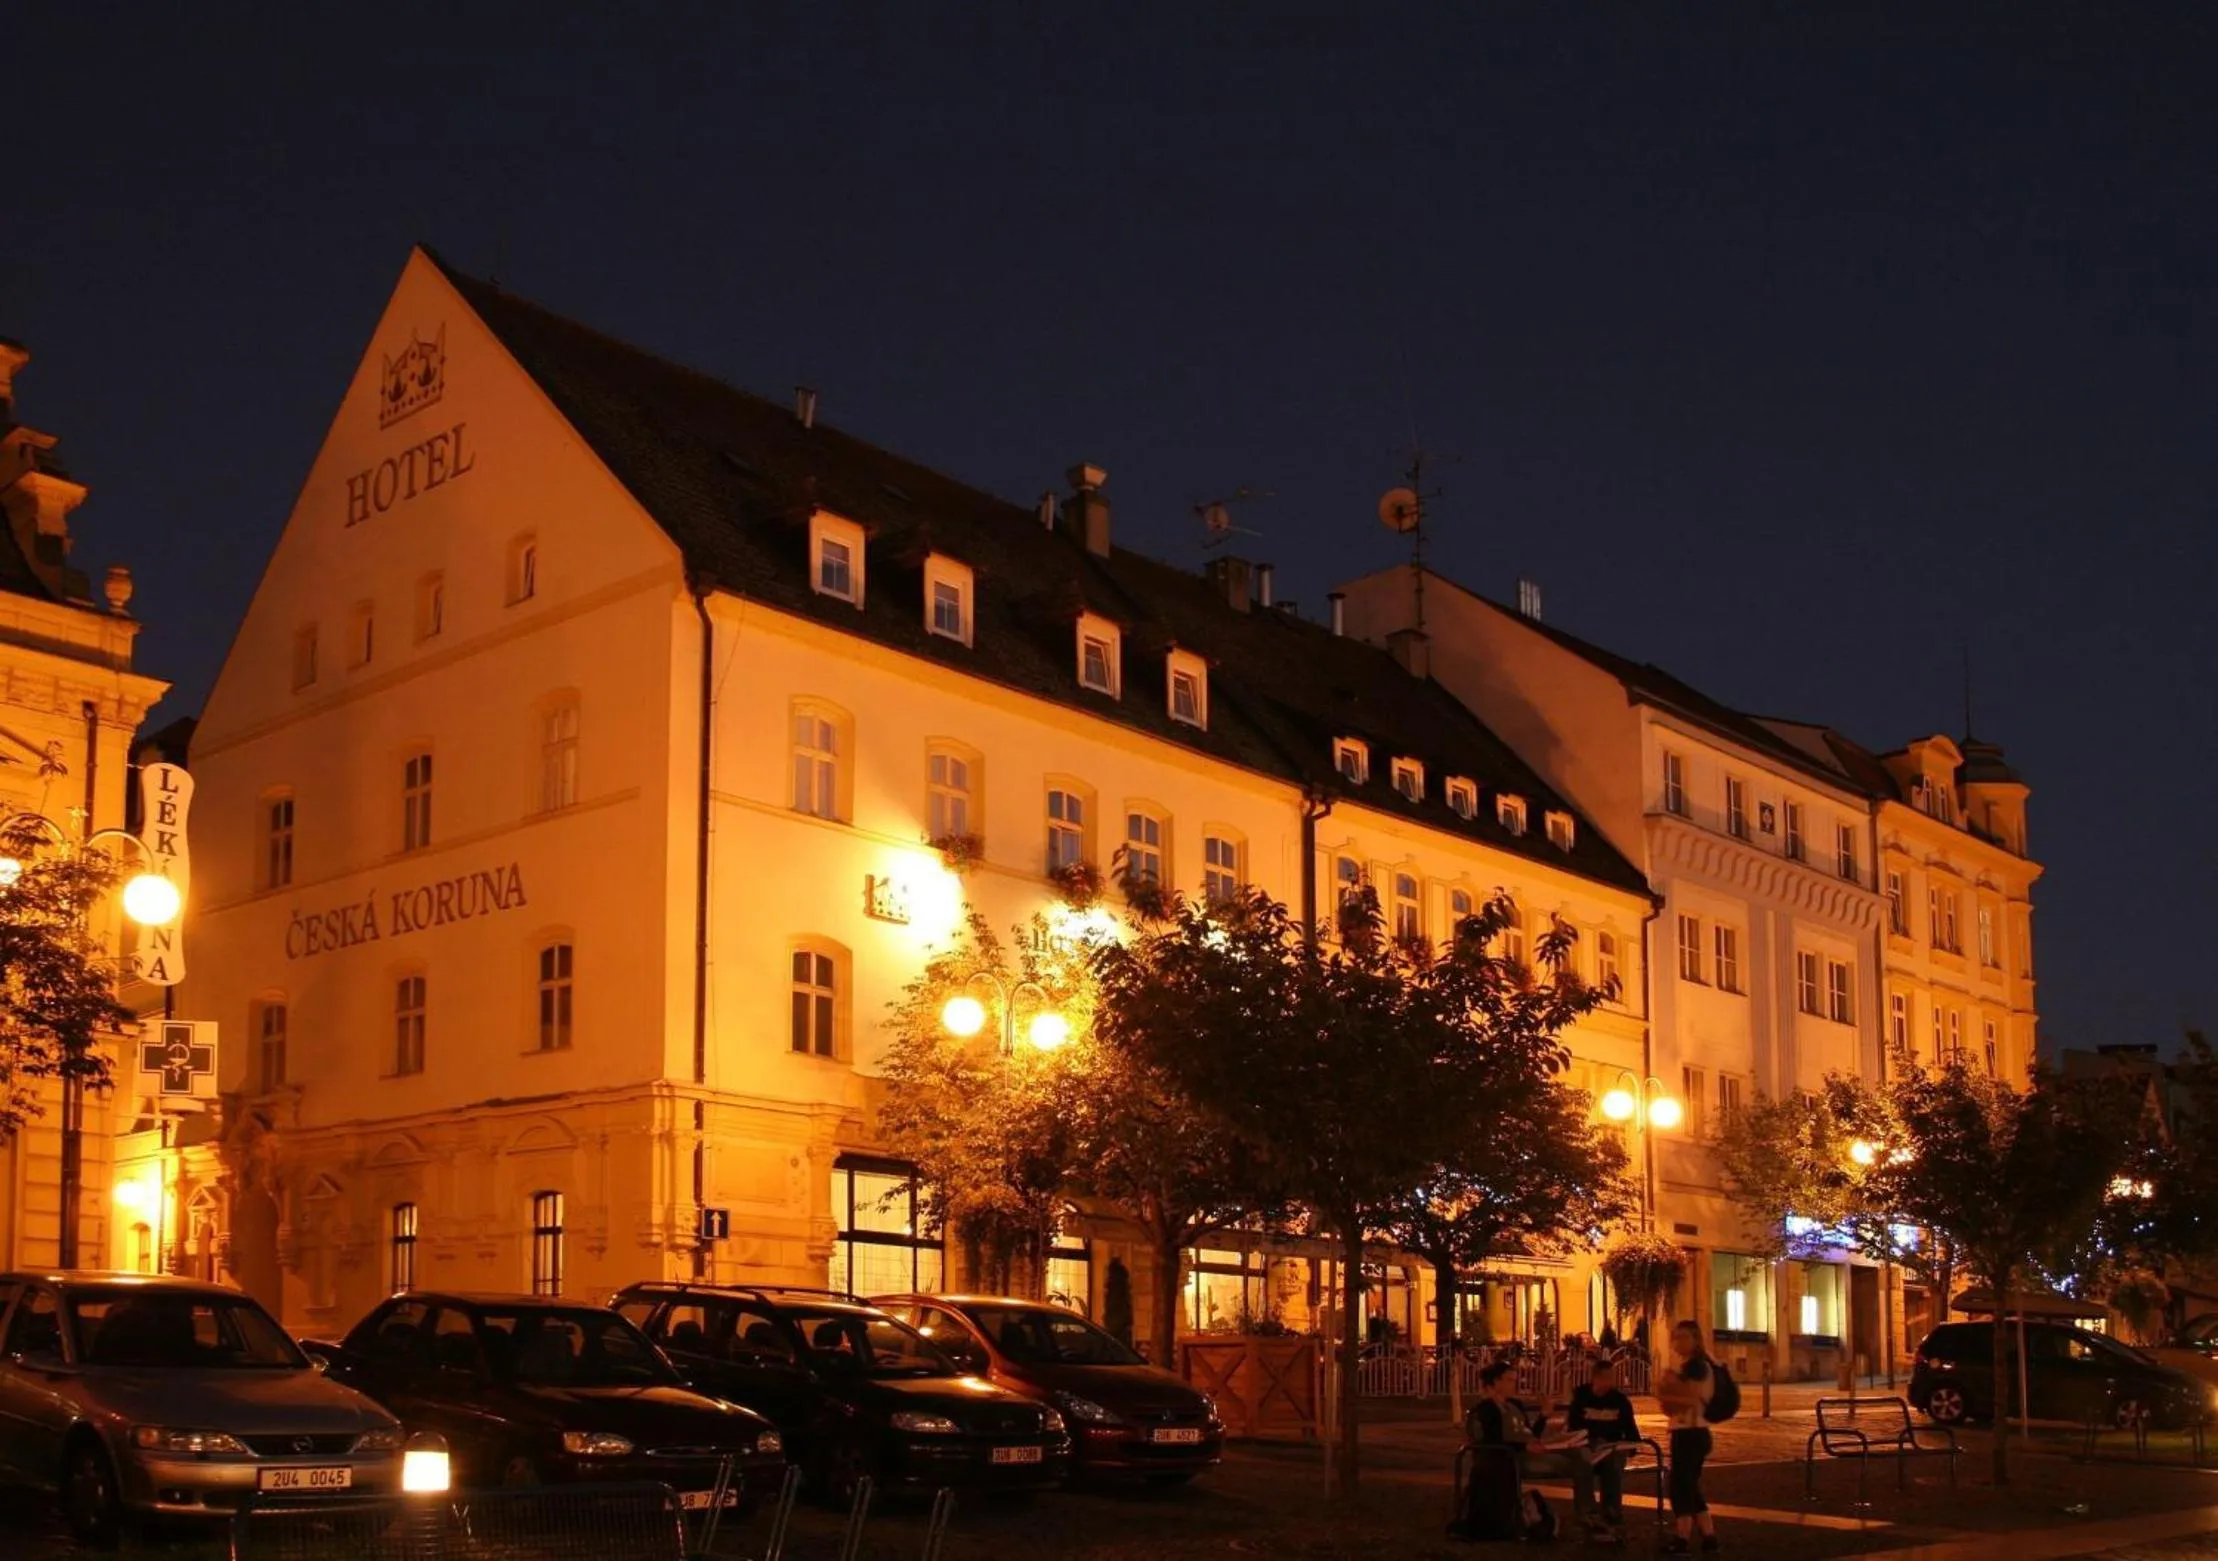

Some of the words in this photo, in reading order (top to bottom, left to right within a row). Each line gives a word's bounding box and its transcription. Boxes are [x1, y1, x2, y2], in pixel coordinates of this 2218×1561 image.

[344, 421, 476, 528] HOTEL
[285, 888, 381, 960] ČESKÁ
[390, 862, 528, 937] KORUNA
[273, 1470, 299, 1487] 2U4
[310, 1469, 345, 1485] 0045
